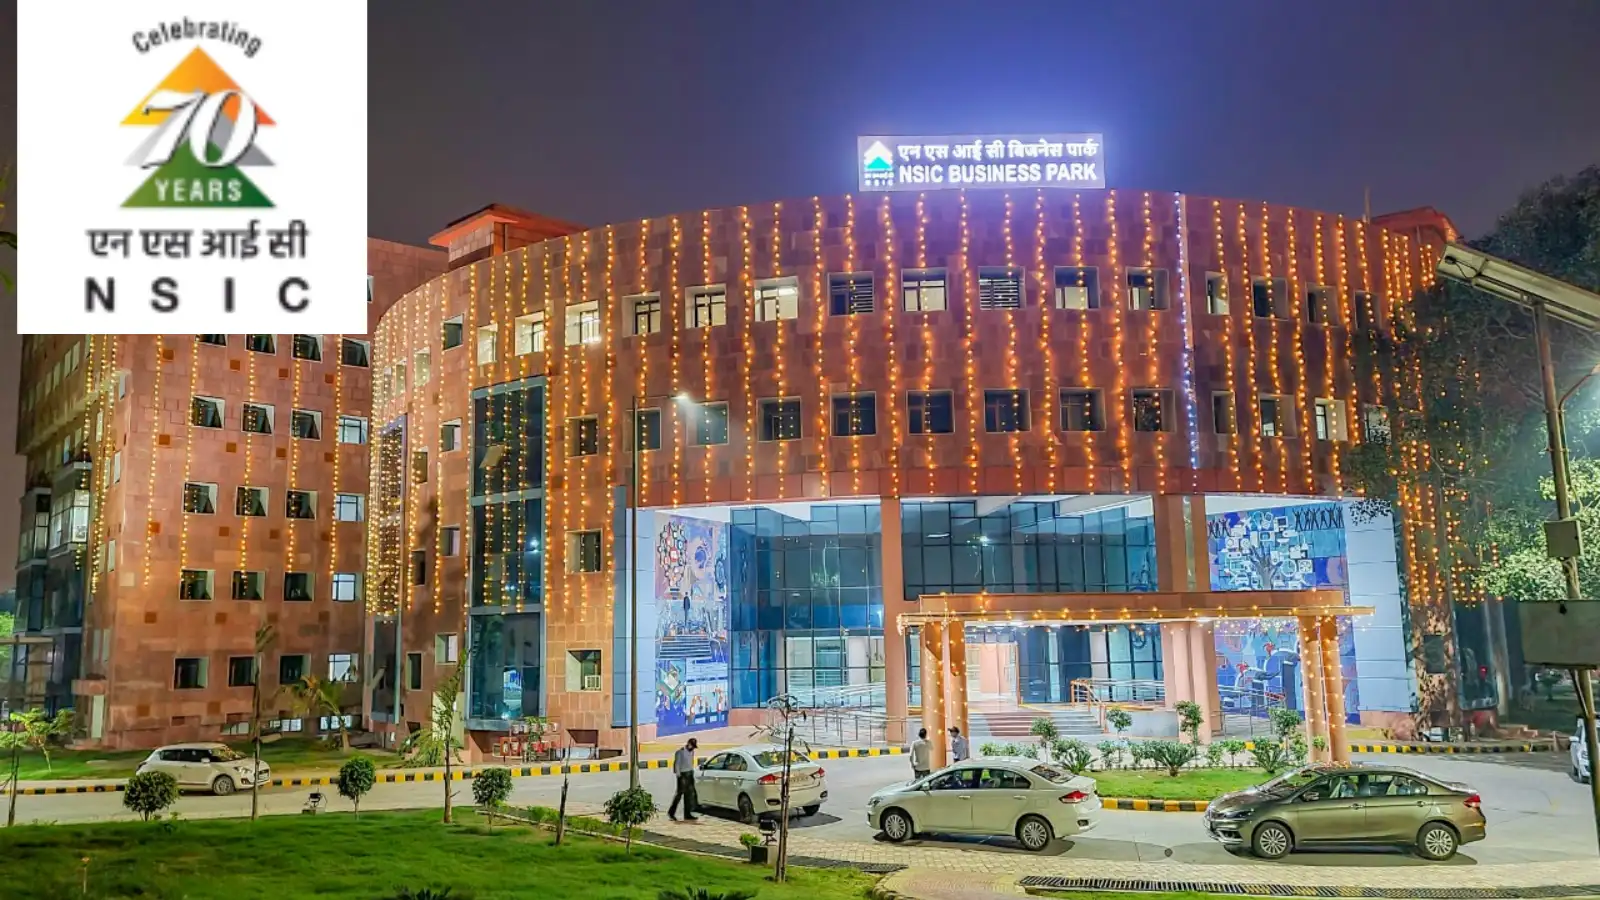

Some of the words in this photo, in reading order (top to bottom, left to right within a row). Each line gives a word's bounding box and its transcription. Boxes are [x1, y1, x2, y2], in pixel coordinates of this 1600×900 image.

[897, 145, 921, 161] एन
[924, 145, 949, 161] एस
[952, 139, 982, 161] आई
[985, 139, 1005, 158] सी
[1008, 137, 1063, 158] बिजनेस
[1066, 138, 1099, 157] पार्क
[899, 164, 943, 183] NSIC
[948, 164, 1041, 183] BUSINESS
[1045, 163, 1097, 181] PARK
